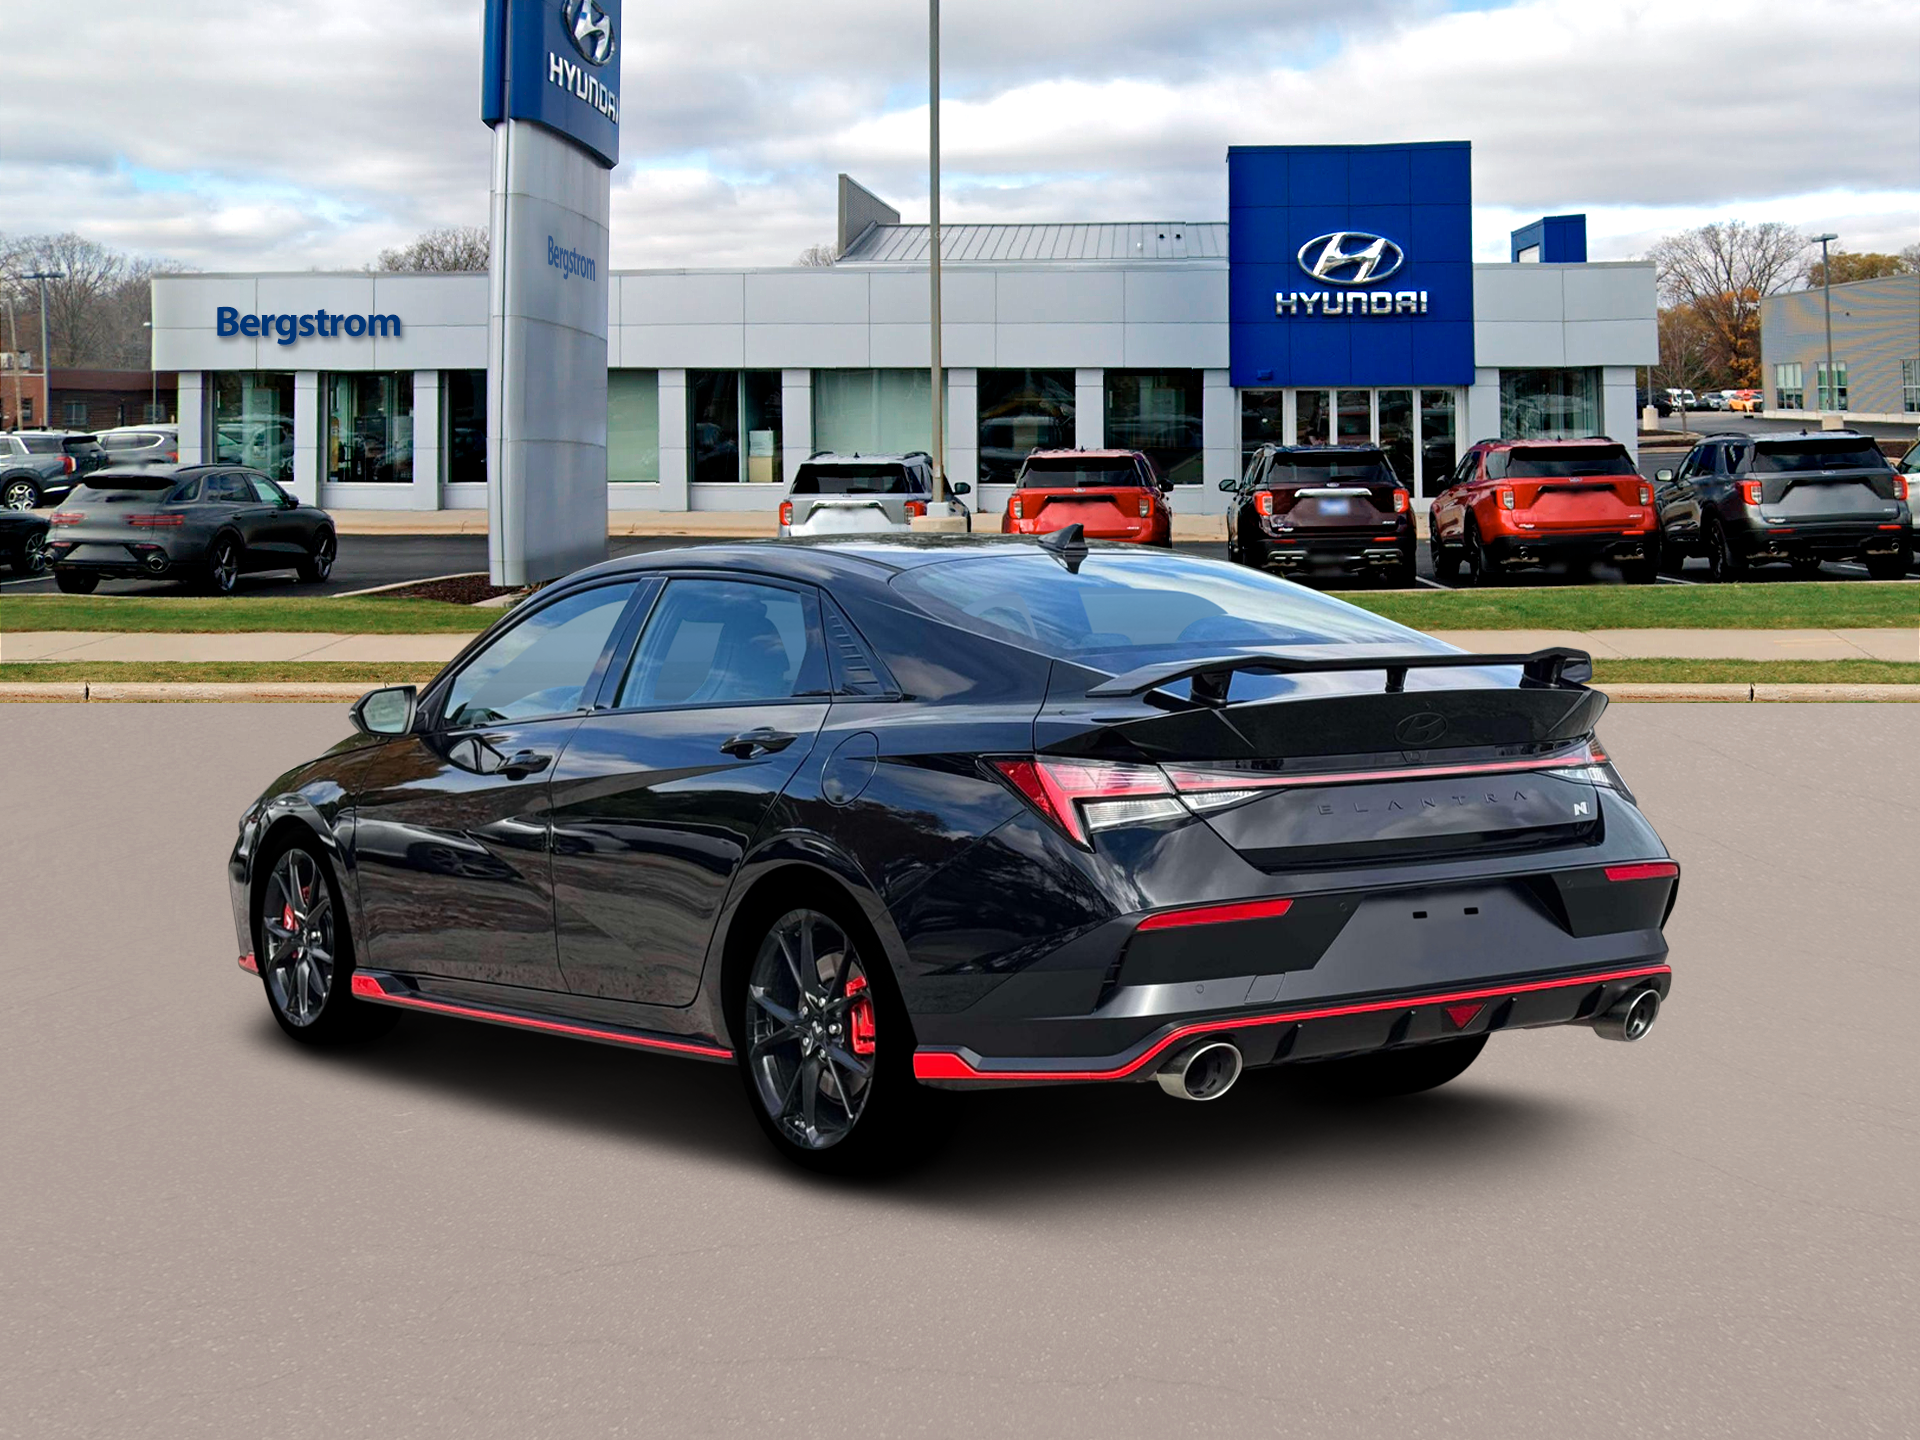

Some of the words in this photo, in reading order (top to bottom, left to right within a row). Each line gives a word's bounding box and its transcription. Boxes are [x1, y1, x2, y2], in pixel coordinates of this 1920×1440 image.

[549, 52, 619, 123] HYUNDAI
[548, 235, 596, 282] Bergstrom
[1276, 291, 1428, 315] HYUNDAI
[217, 306, 401, 345] Bergstrom
[1318, 791, 1527, 816] ELANTRA
[1573, 801, 1590, 816] N
